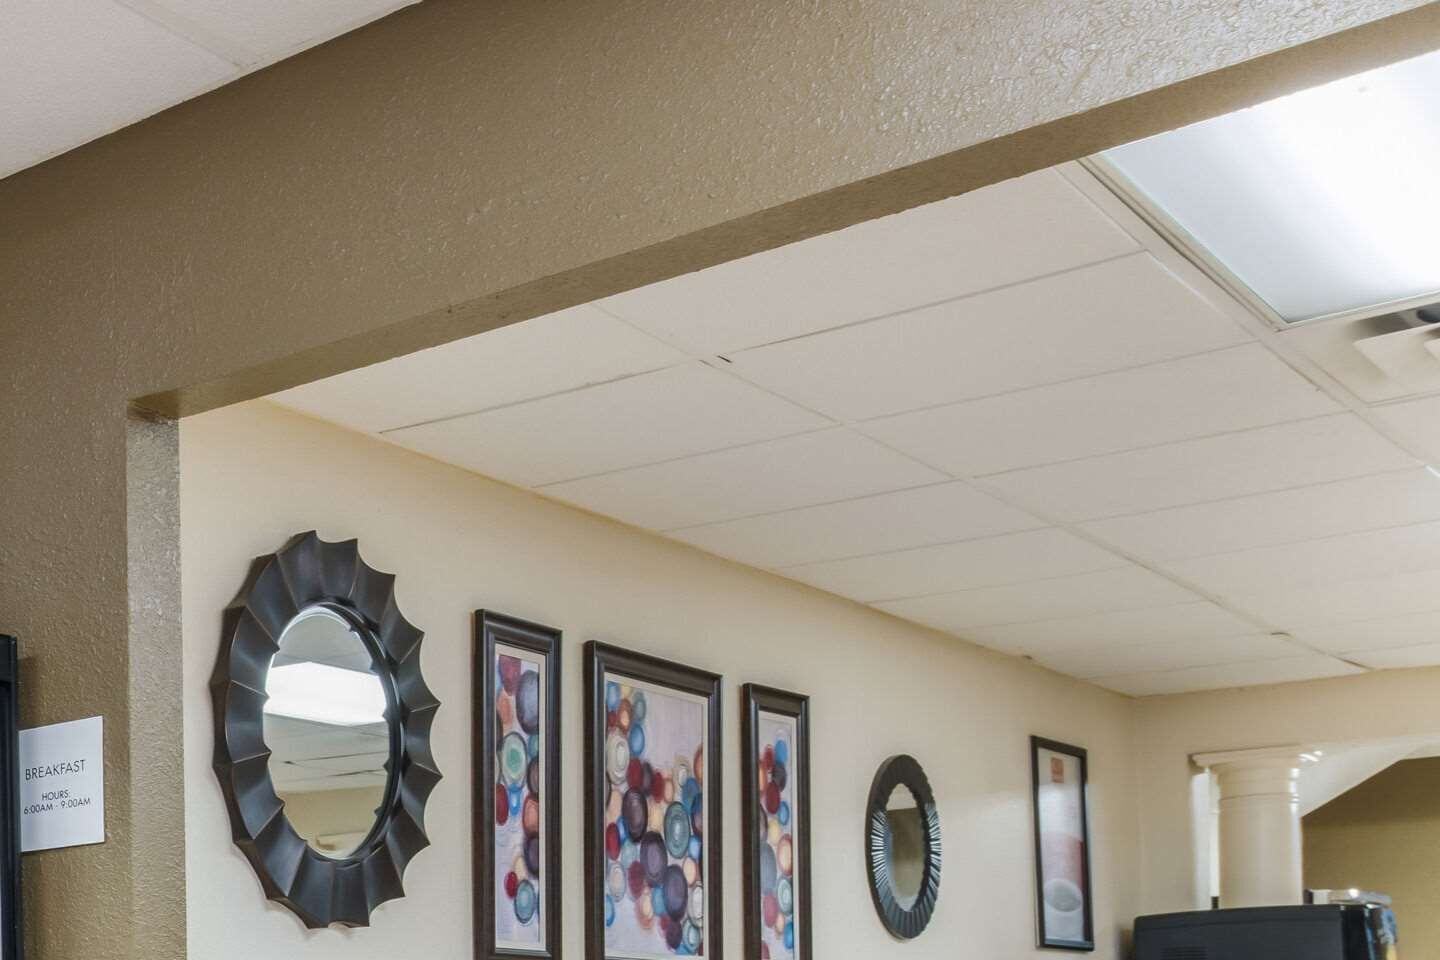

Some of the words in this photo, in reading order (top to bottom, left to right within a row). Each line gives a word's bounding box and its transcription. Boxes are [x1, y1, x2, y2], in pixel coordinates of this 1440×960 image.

[25, 759, 86, 780] BREAKFAST
[41, 790, 71, 801] HOURS:
[23, 804, 54, 815] 6:00AM
[60, 798, 91, 809] 9:00AM
